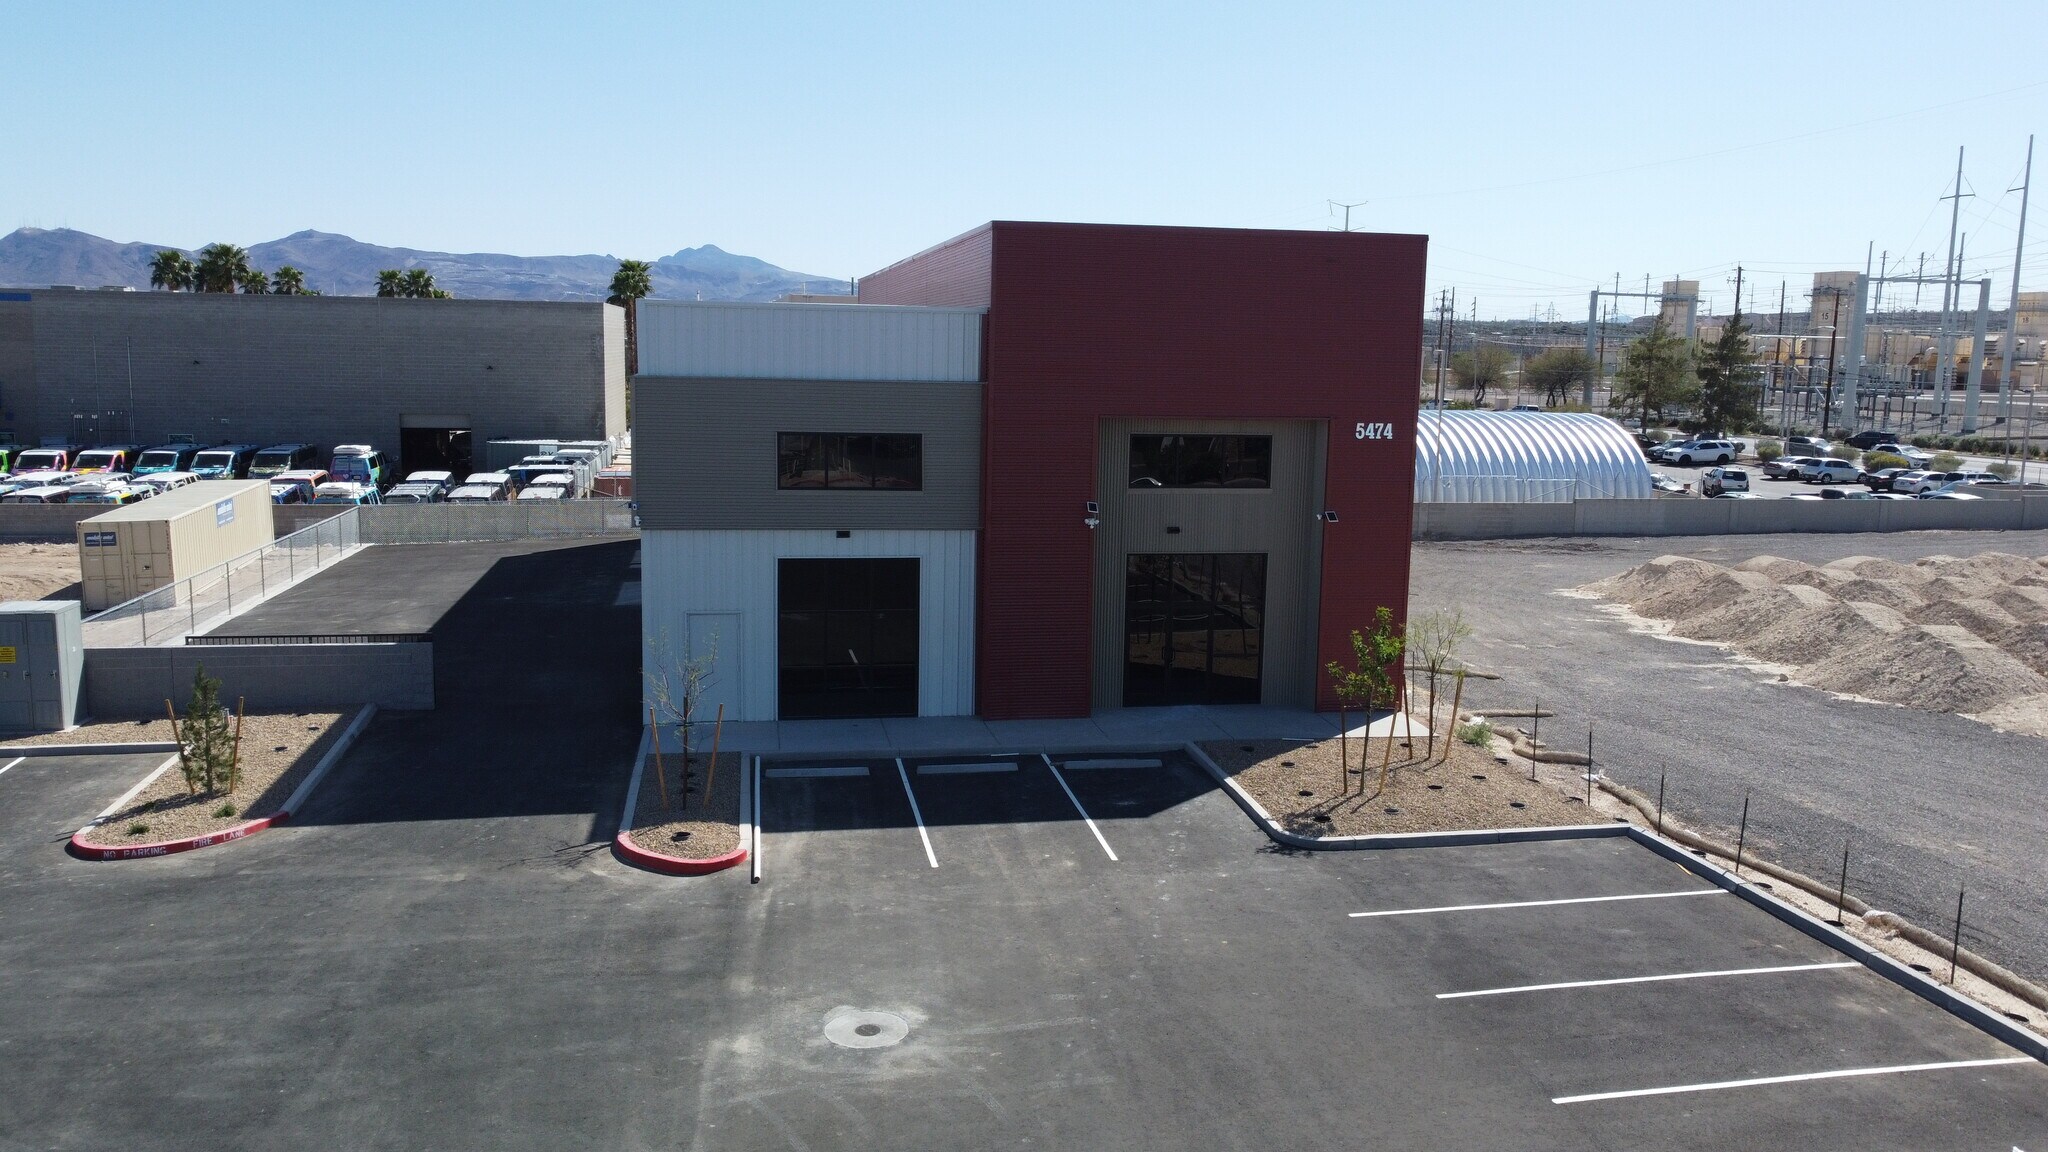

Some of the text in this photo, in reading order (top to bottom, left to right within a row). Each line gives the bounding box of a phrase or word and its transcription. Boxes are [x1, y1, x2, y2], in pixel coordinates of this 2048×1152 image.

[1821, 312, 1829, 320] 15
[1355, 422, 1393, 440] 5474
[103, 829, 245, 859] NO PARKING FIRE LANE
